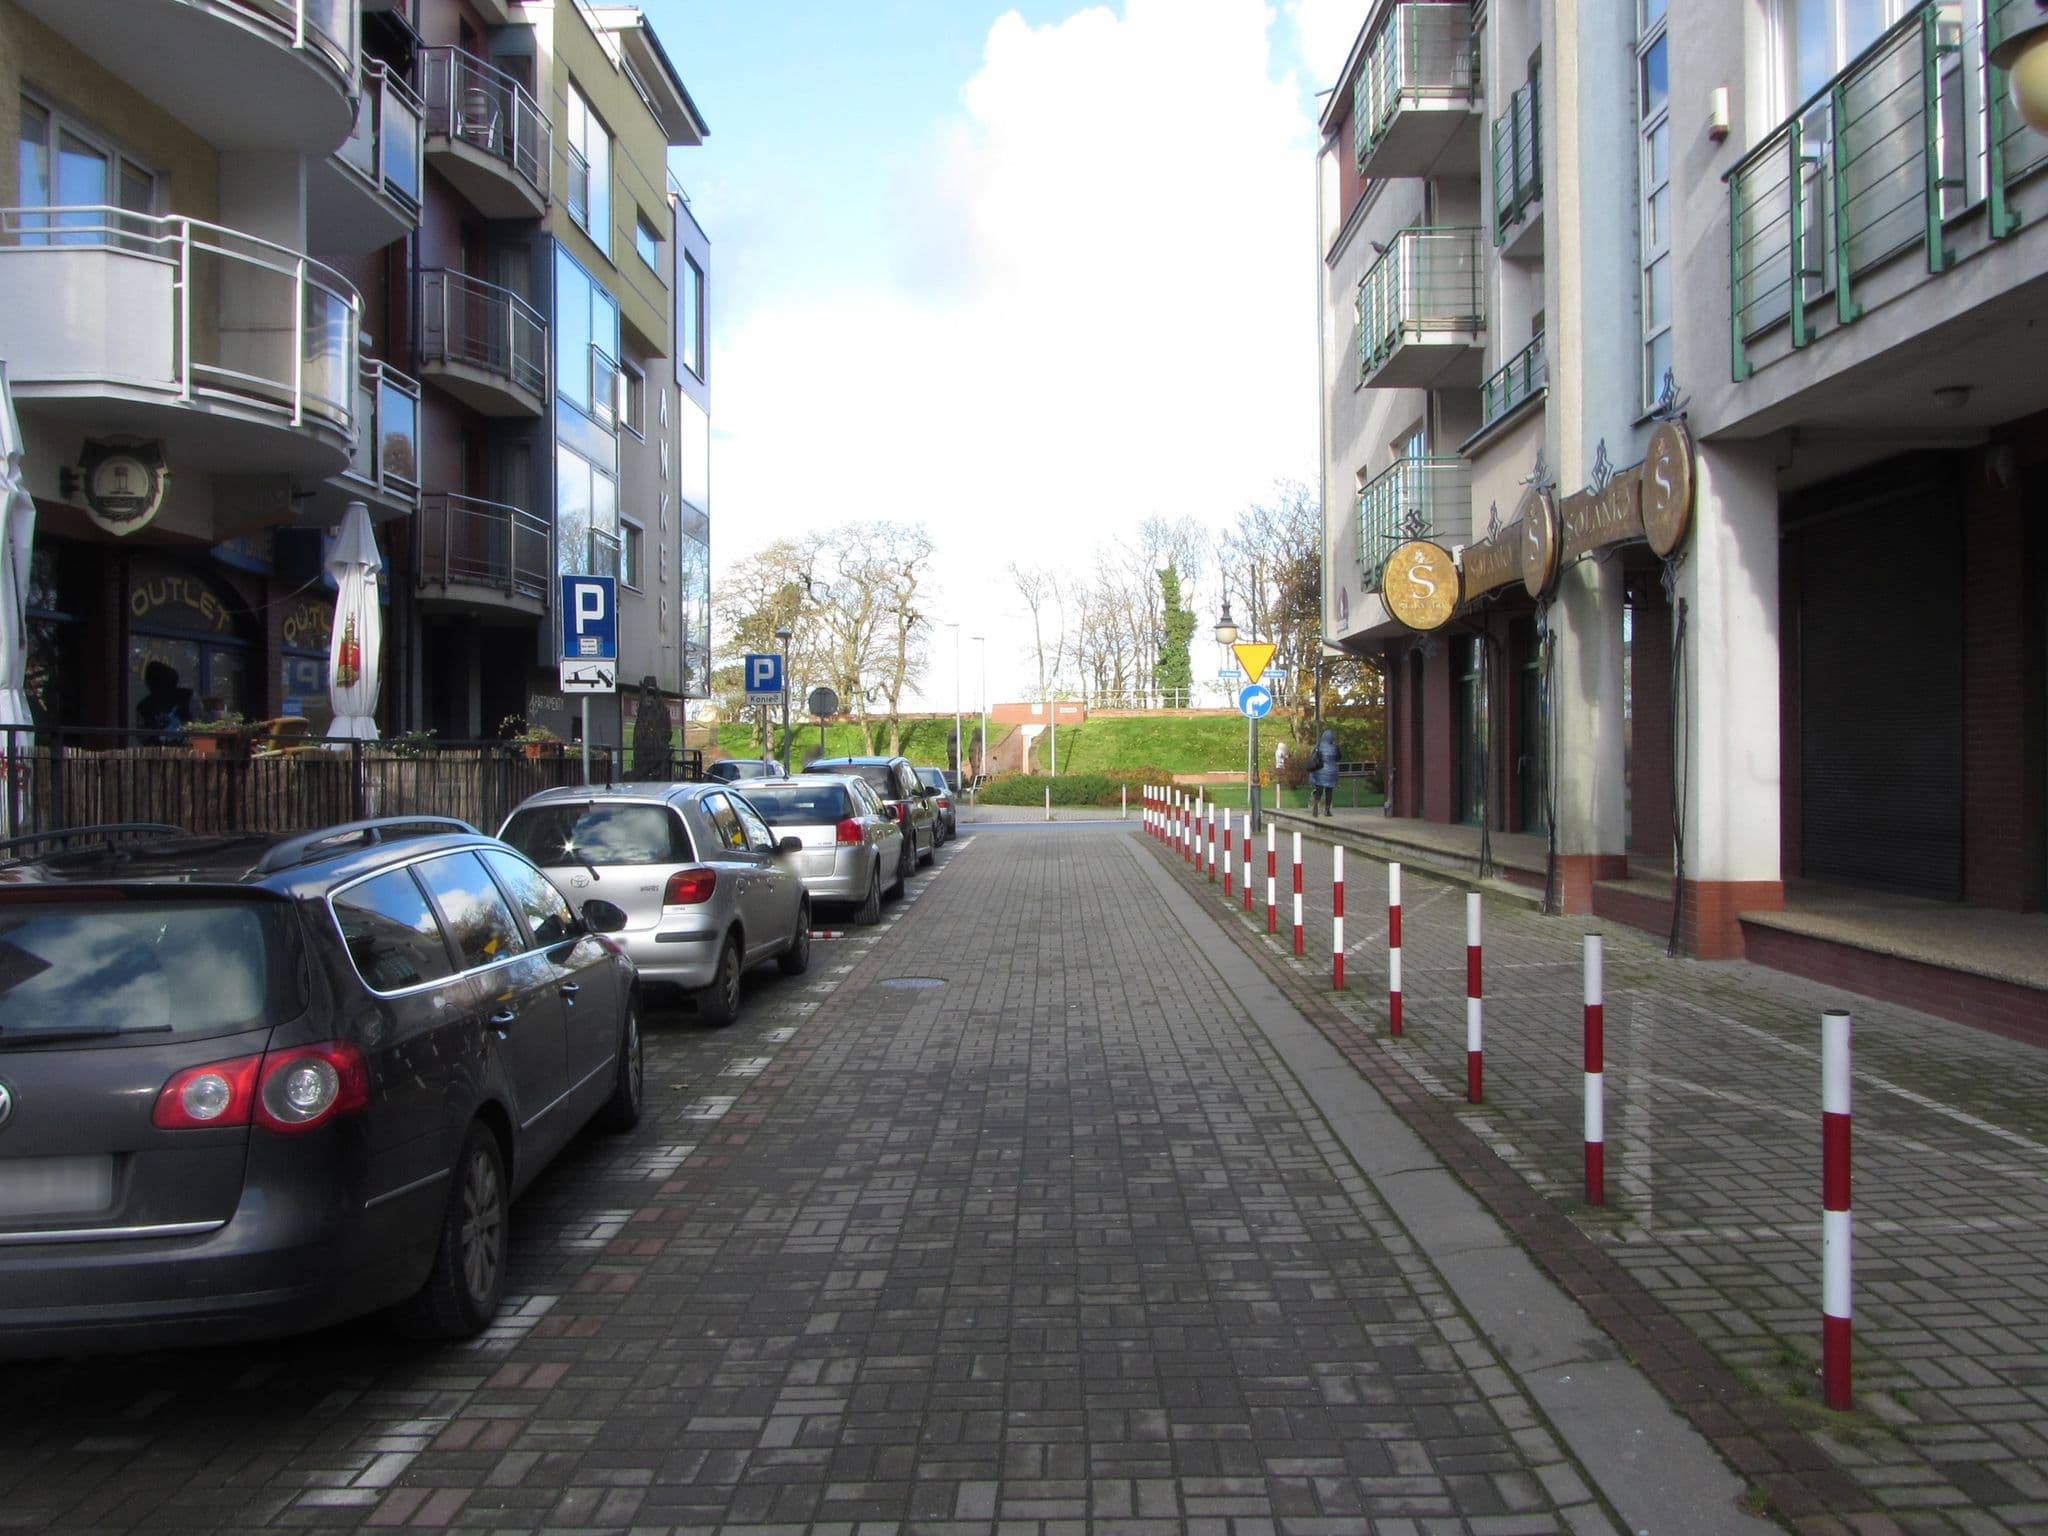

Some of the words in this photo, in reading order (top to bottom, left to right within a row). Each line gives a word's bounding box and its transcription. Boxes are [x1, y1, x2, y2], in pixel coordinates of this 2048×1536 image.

[131, 575, 232, 631] OUTLET
[283, 601, 331, 641] OUTL
[575, 583, 605, 635] P
[753, 658, 775, 688] P
